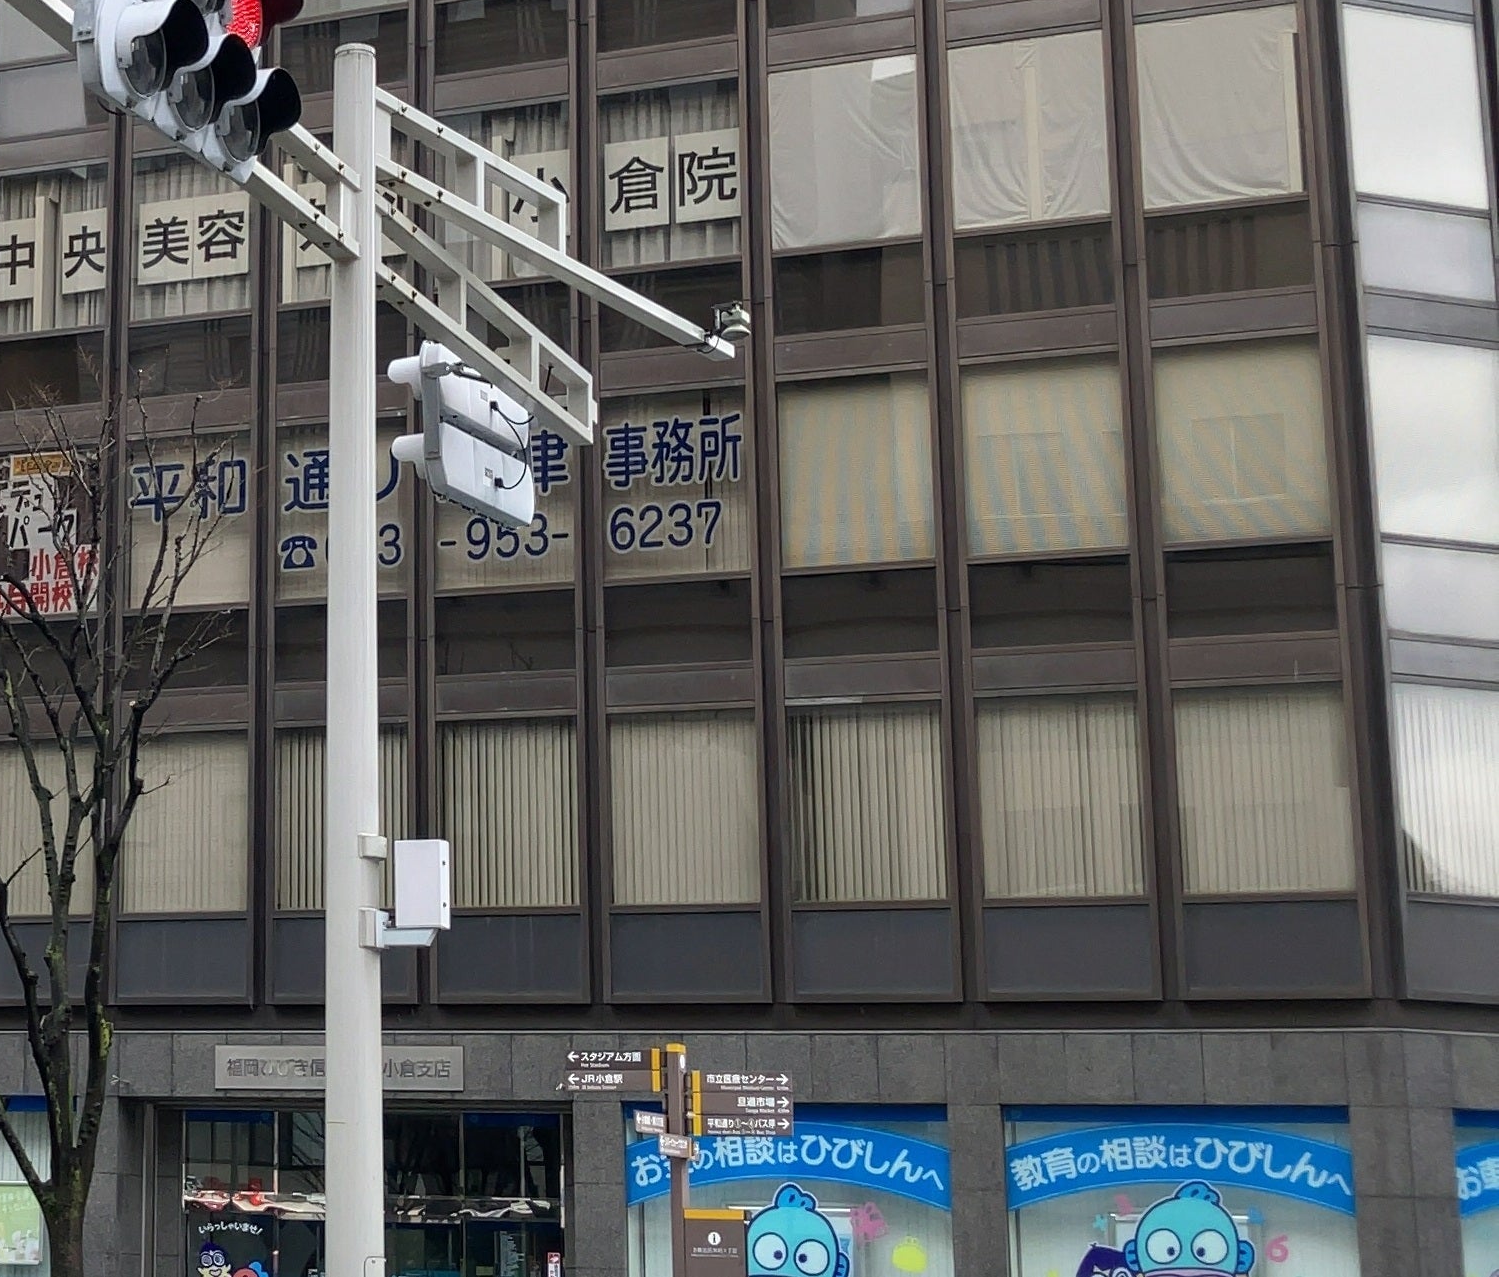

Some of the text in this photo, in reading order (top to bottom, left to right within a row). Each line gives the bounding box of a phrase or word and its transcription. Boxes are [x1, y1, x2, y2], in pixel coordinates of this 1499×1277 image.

[580, 1051, 641, 1062] スタジアム方面
[581, 1073, 623, 1084] JR小倉駅
[706, 1074, 775, 1084] 市立医療センター
[737, 1096, 775, 1107] 旦過市場
[1010, 1135, 1353, 1197] 教育の相談はひびしんへ
